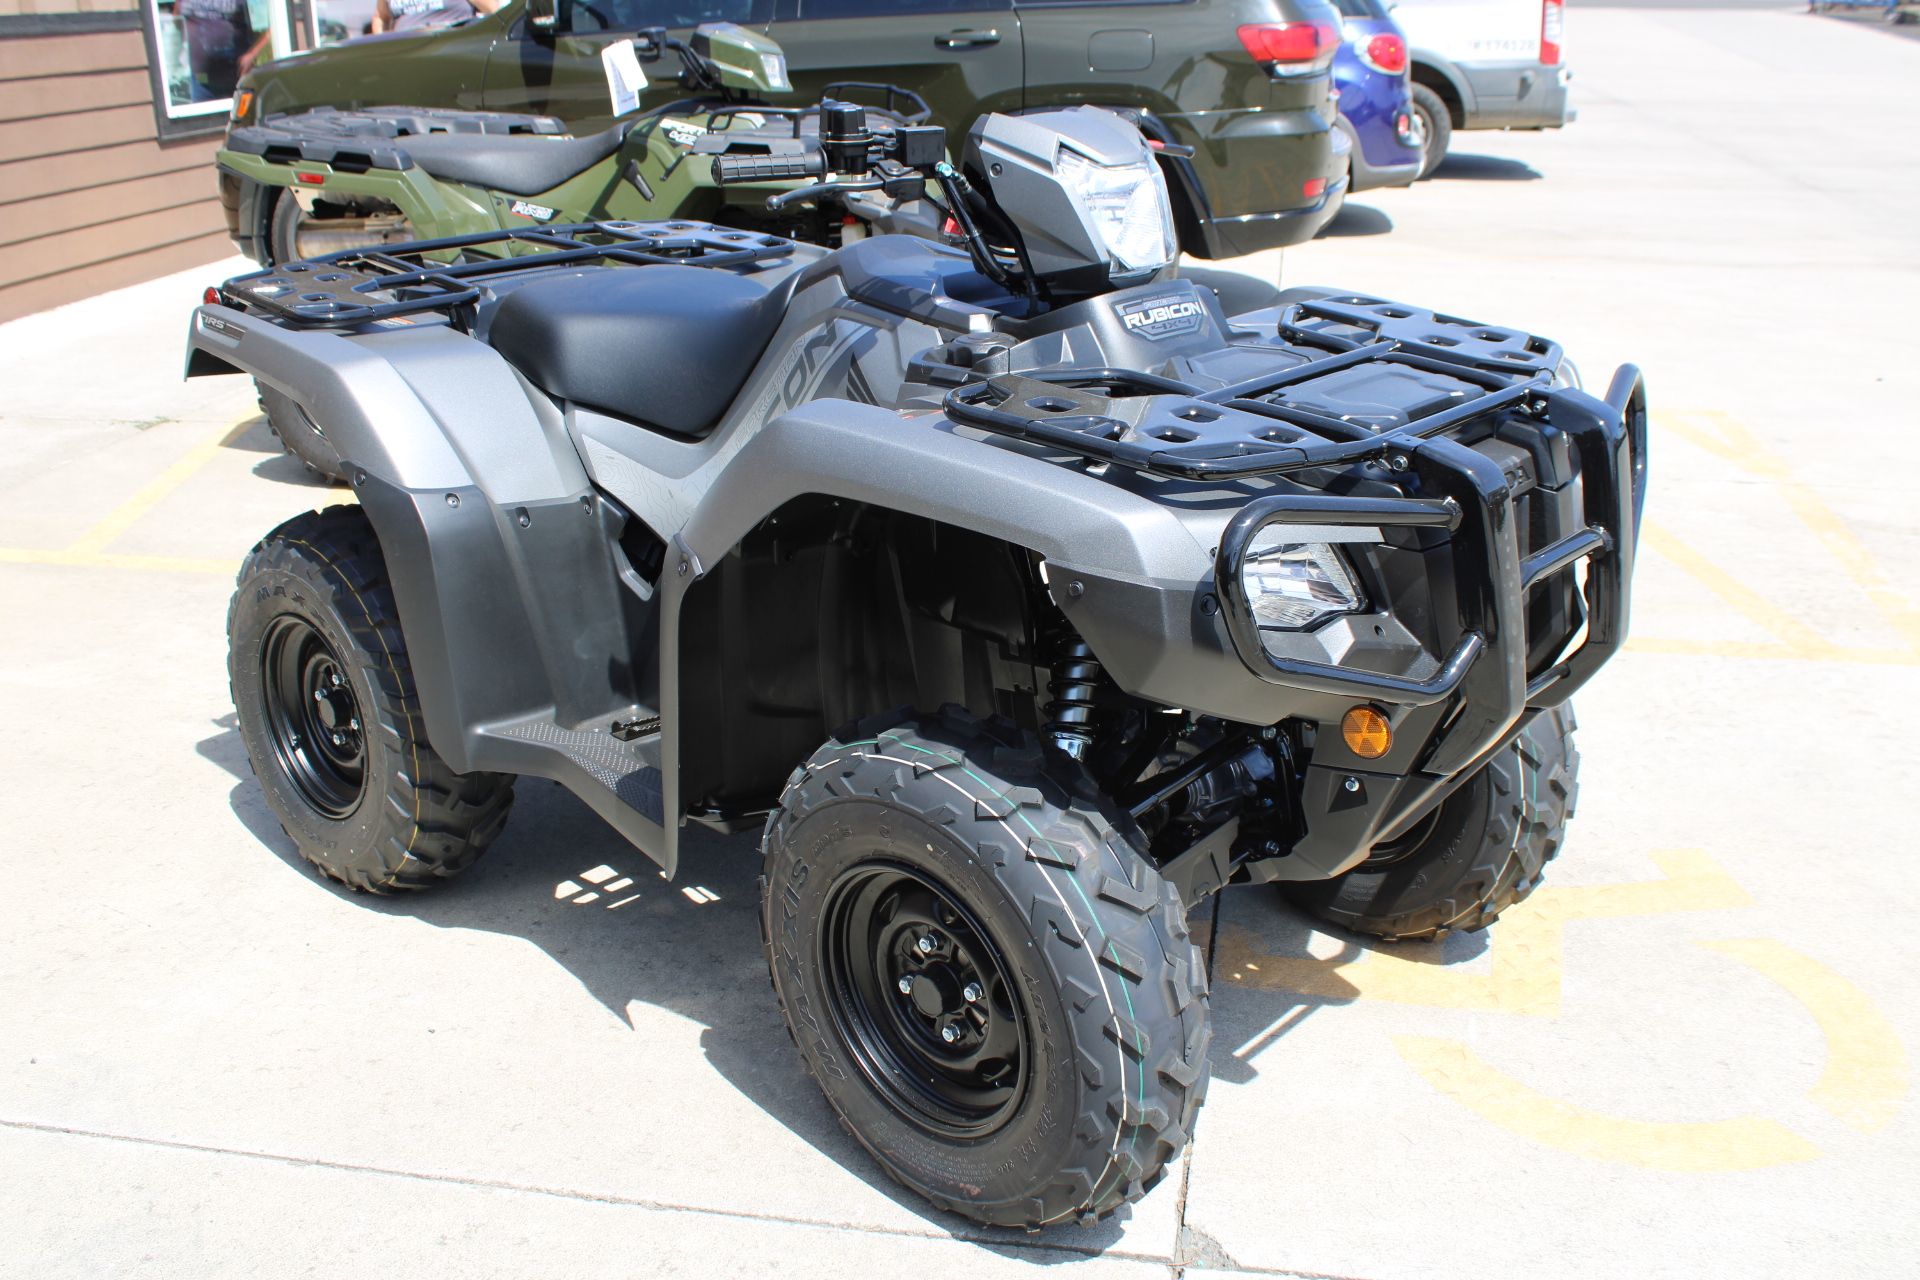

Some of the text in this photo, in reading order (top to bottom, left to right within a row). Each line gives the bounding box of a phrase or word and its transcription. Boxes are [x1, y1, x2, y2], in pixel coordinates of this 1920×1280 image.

[204, 315, 225, 329] IRS
[1124, 302, 1202, 329] RUBICON
[735, 334, 809, 449] FOREMAN
[781, 856, 847, 1080] MAXXIS
